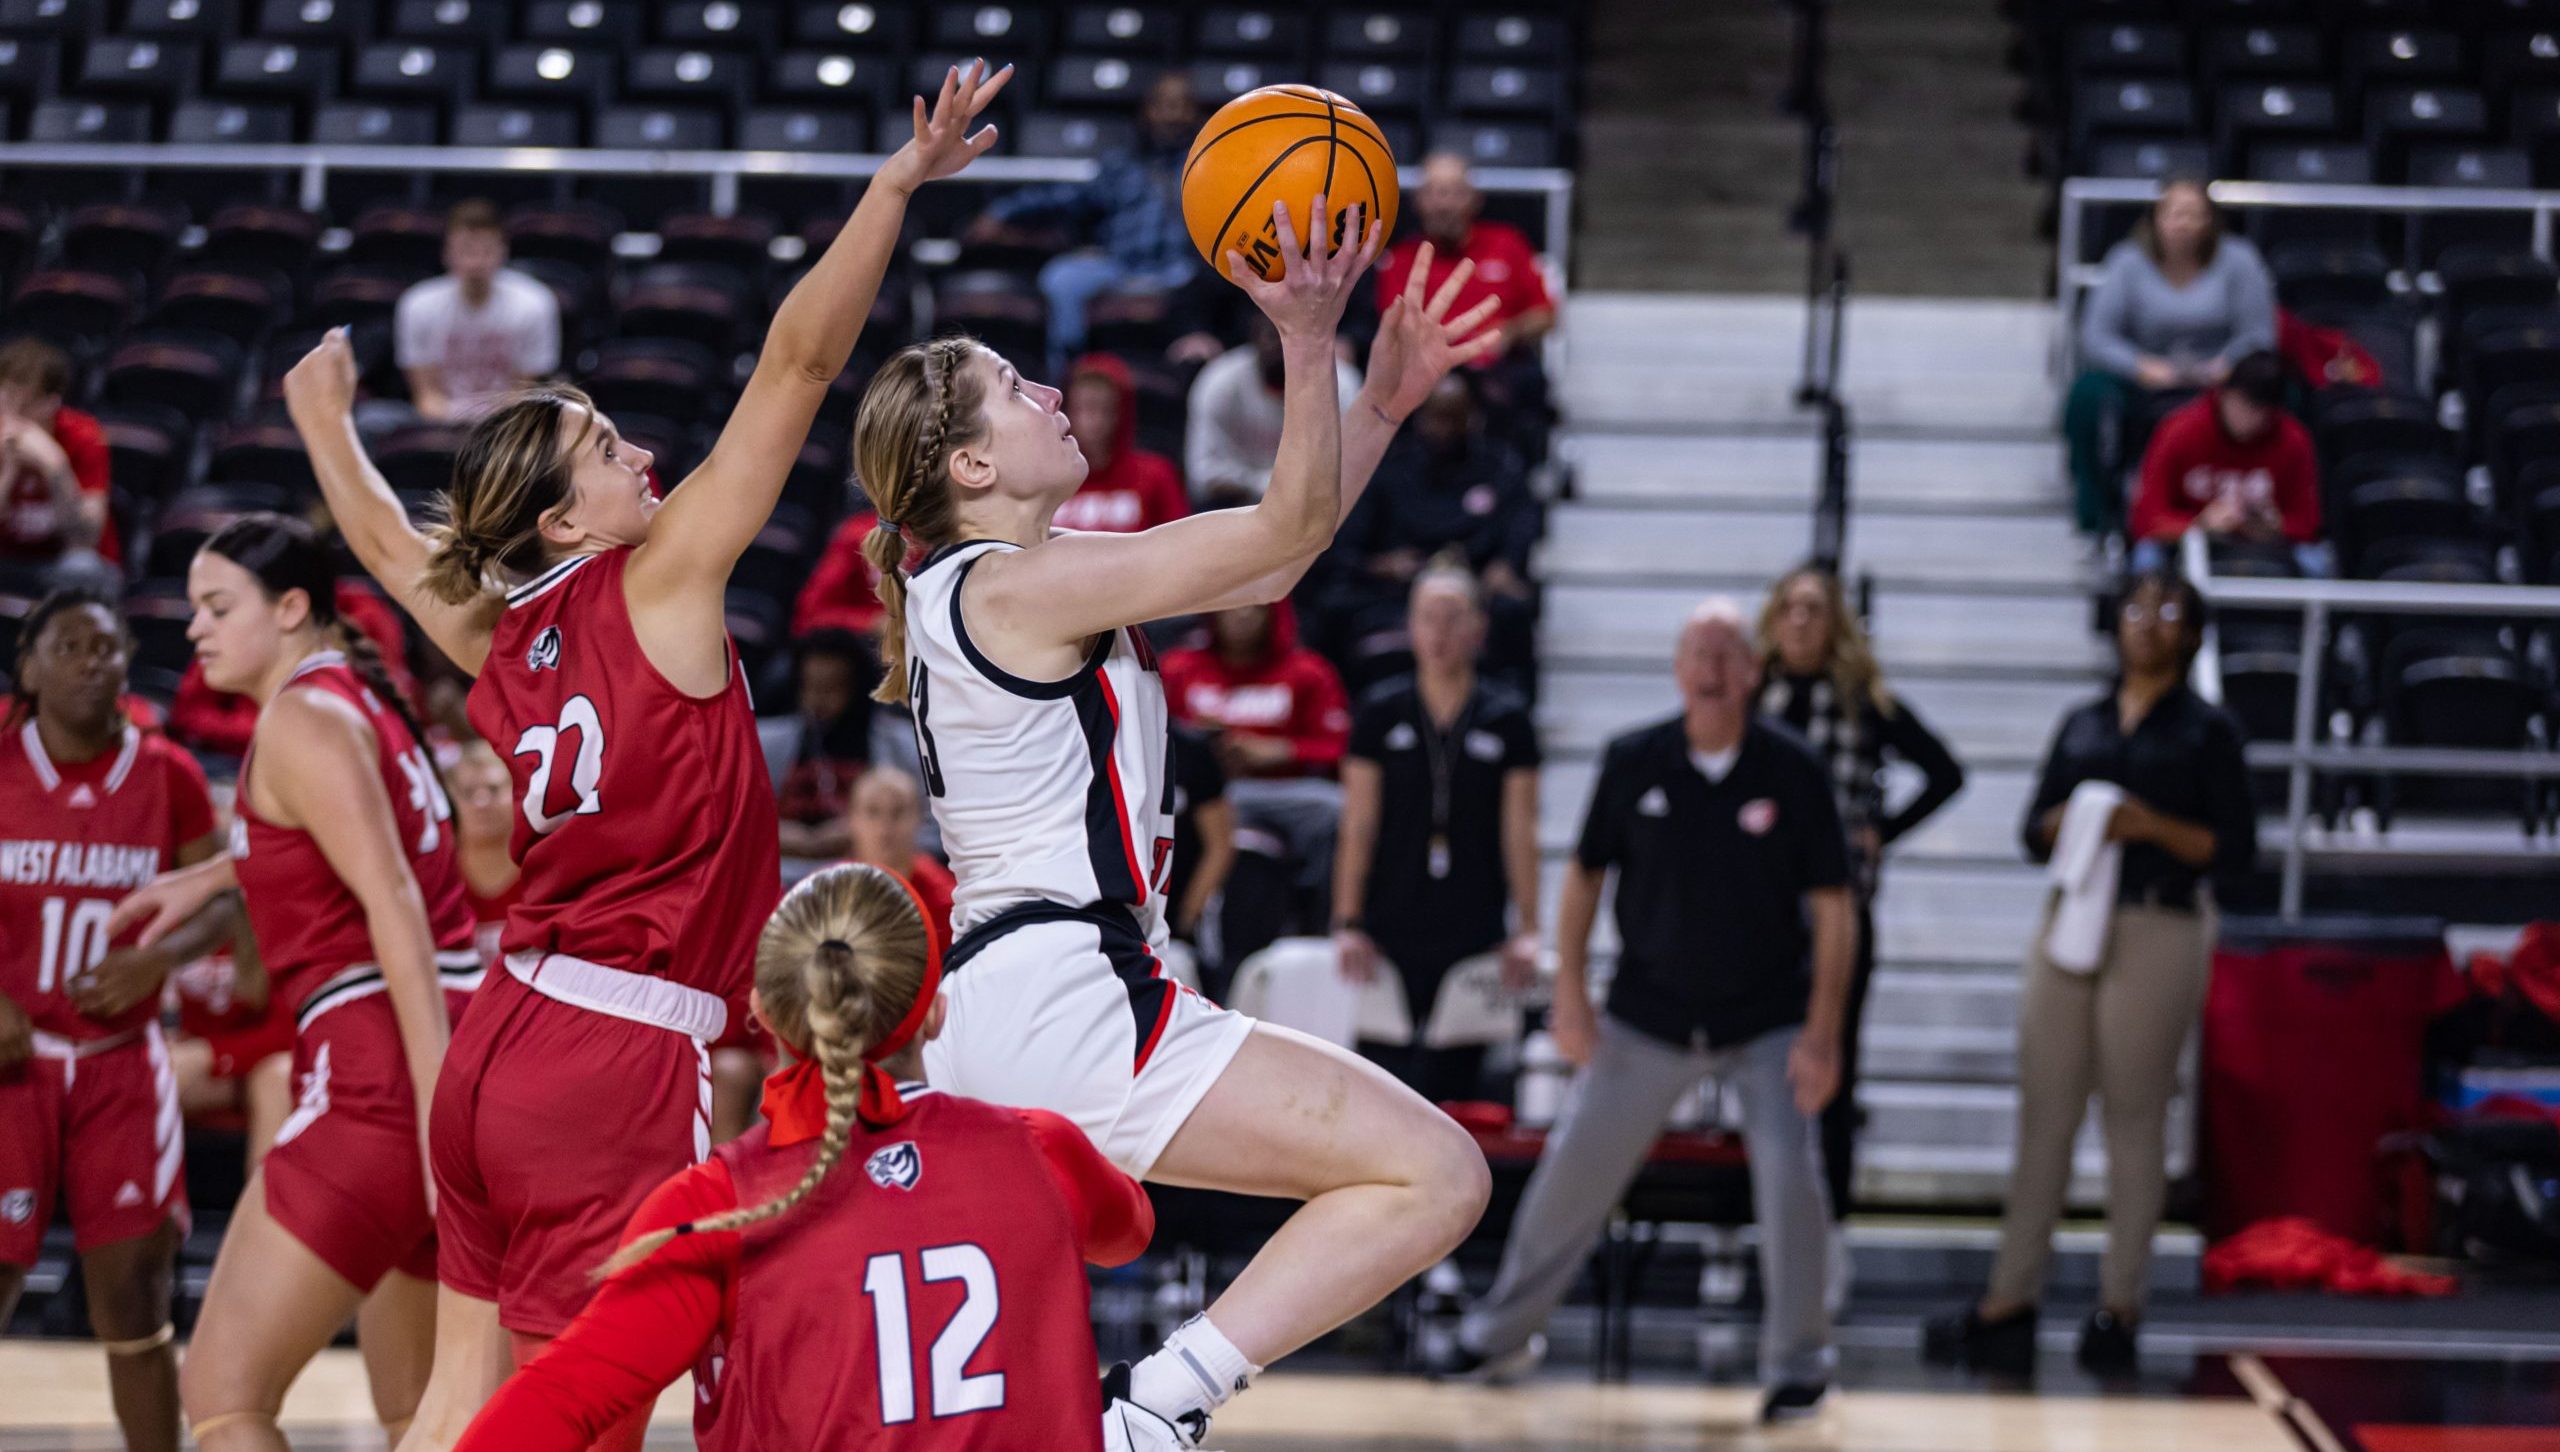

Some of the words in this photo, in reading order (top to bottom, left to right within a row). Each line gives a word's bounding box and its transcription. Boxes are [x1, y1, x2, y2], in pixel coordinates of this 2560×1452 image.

[513, 693, 605, 834] 22
[1, 840, 56, 884] WEST
[37, 896, 114, 993] 10
[863, 1243, 1006, 1426] 12
